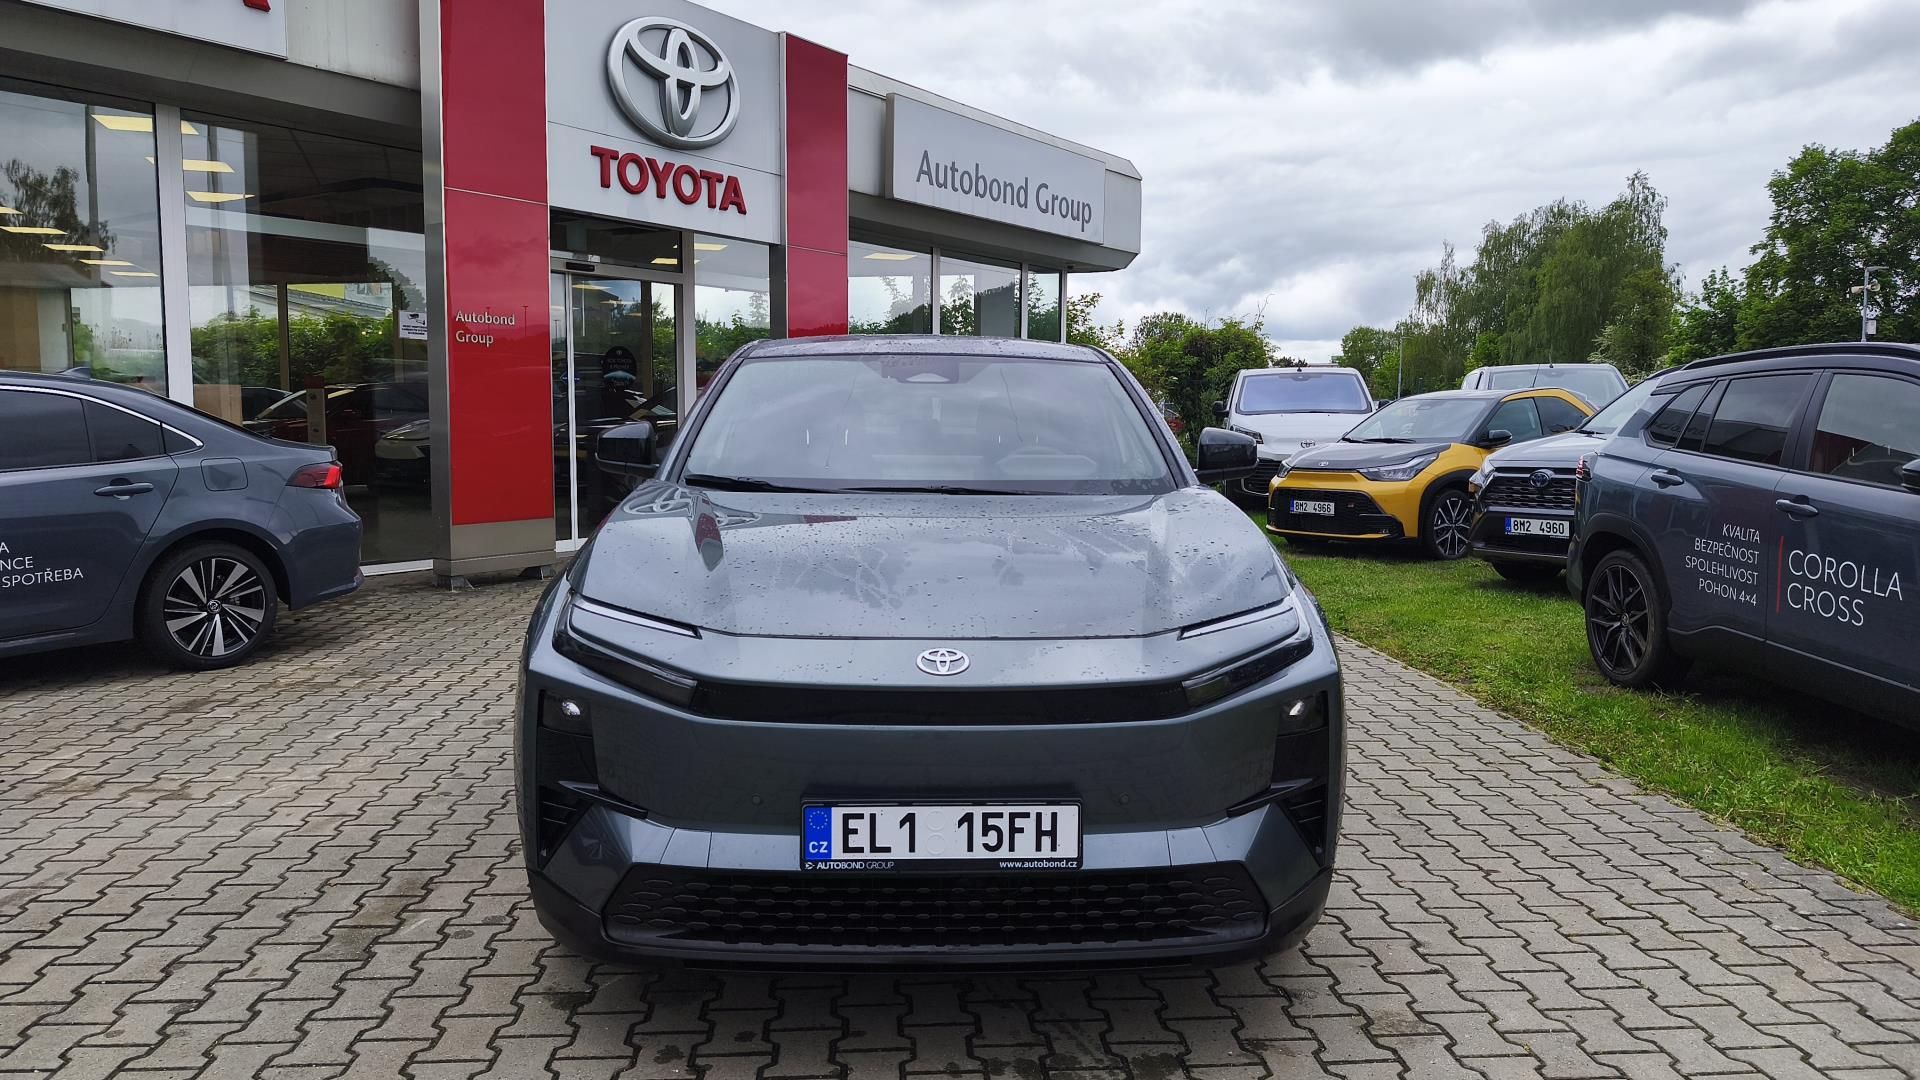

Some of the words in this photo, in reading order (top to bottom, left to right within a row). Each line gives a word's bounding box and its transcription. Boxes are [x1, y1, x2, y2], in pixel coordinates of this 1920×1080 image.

[590, 145, 747, 215] TOYOTA
[915, 149, 1029, 209] Autobond
[1035, 183, 1092, 232] Group
[455, 309, 515, 326] Autobond
[455, 330, 494, 348] Group
[1295, 501, 1308, 512] 8M2
[1312, 503, 1332, 513] 4966
[1512, 519, 1532, 533] 8M2
[1539, 521, 1565, 535] 4960
[1722, 523, 1760, 544] KVALITA
[1694, 537, 1760, 565] BEZPEČNOST
[2, 567, 84, 588] SPOTŘEBA
[1685, 555, 1759, 586] SPOLEHLIVOST
[1788, 549, 1903, 601] COROLLA
[1698, 578, 1737, 601] POHON
[1787, 582, 1864, 626] CROSS
[842, 812, 916, 853] EL1
[957, 811, 1058, 853] 15FH
[808, 841, 829, 853] CZ
[816, 861, 865, 870] AUTOBOND
[866, 861, 895, 869] GROUP
[999, 859, 1078, 868] www.autobond.cz
